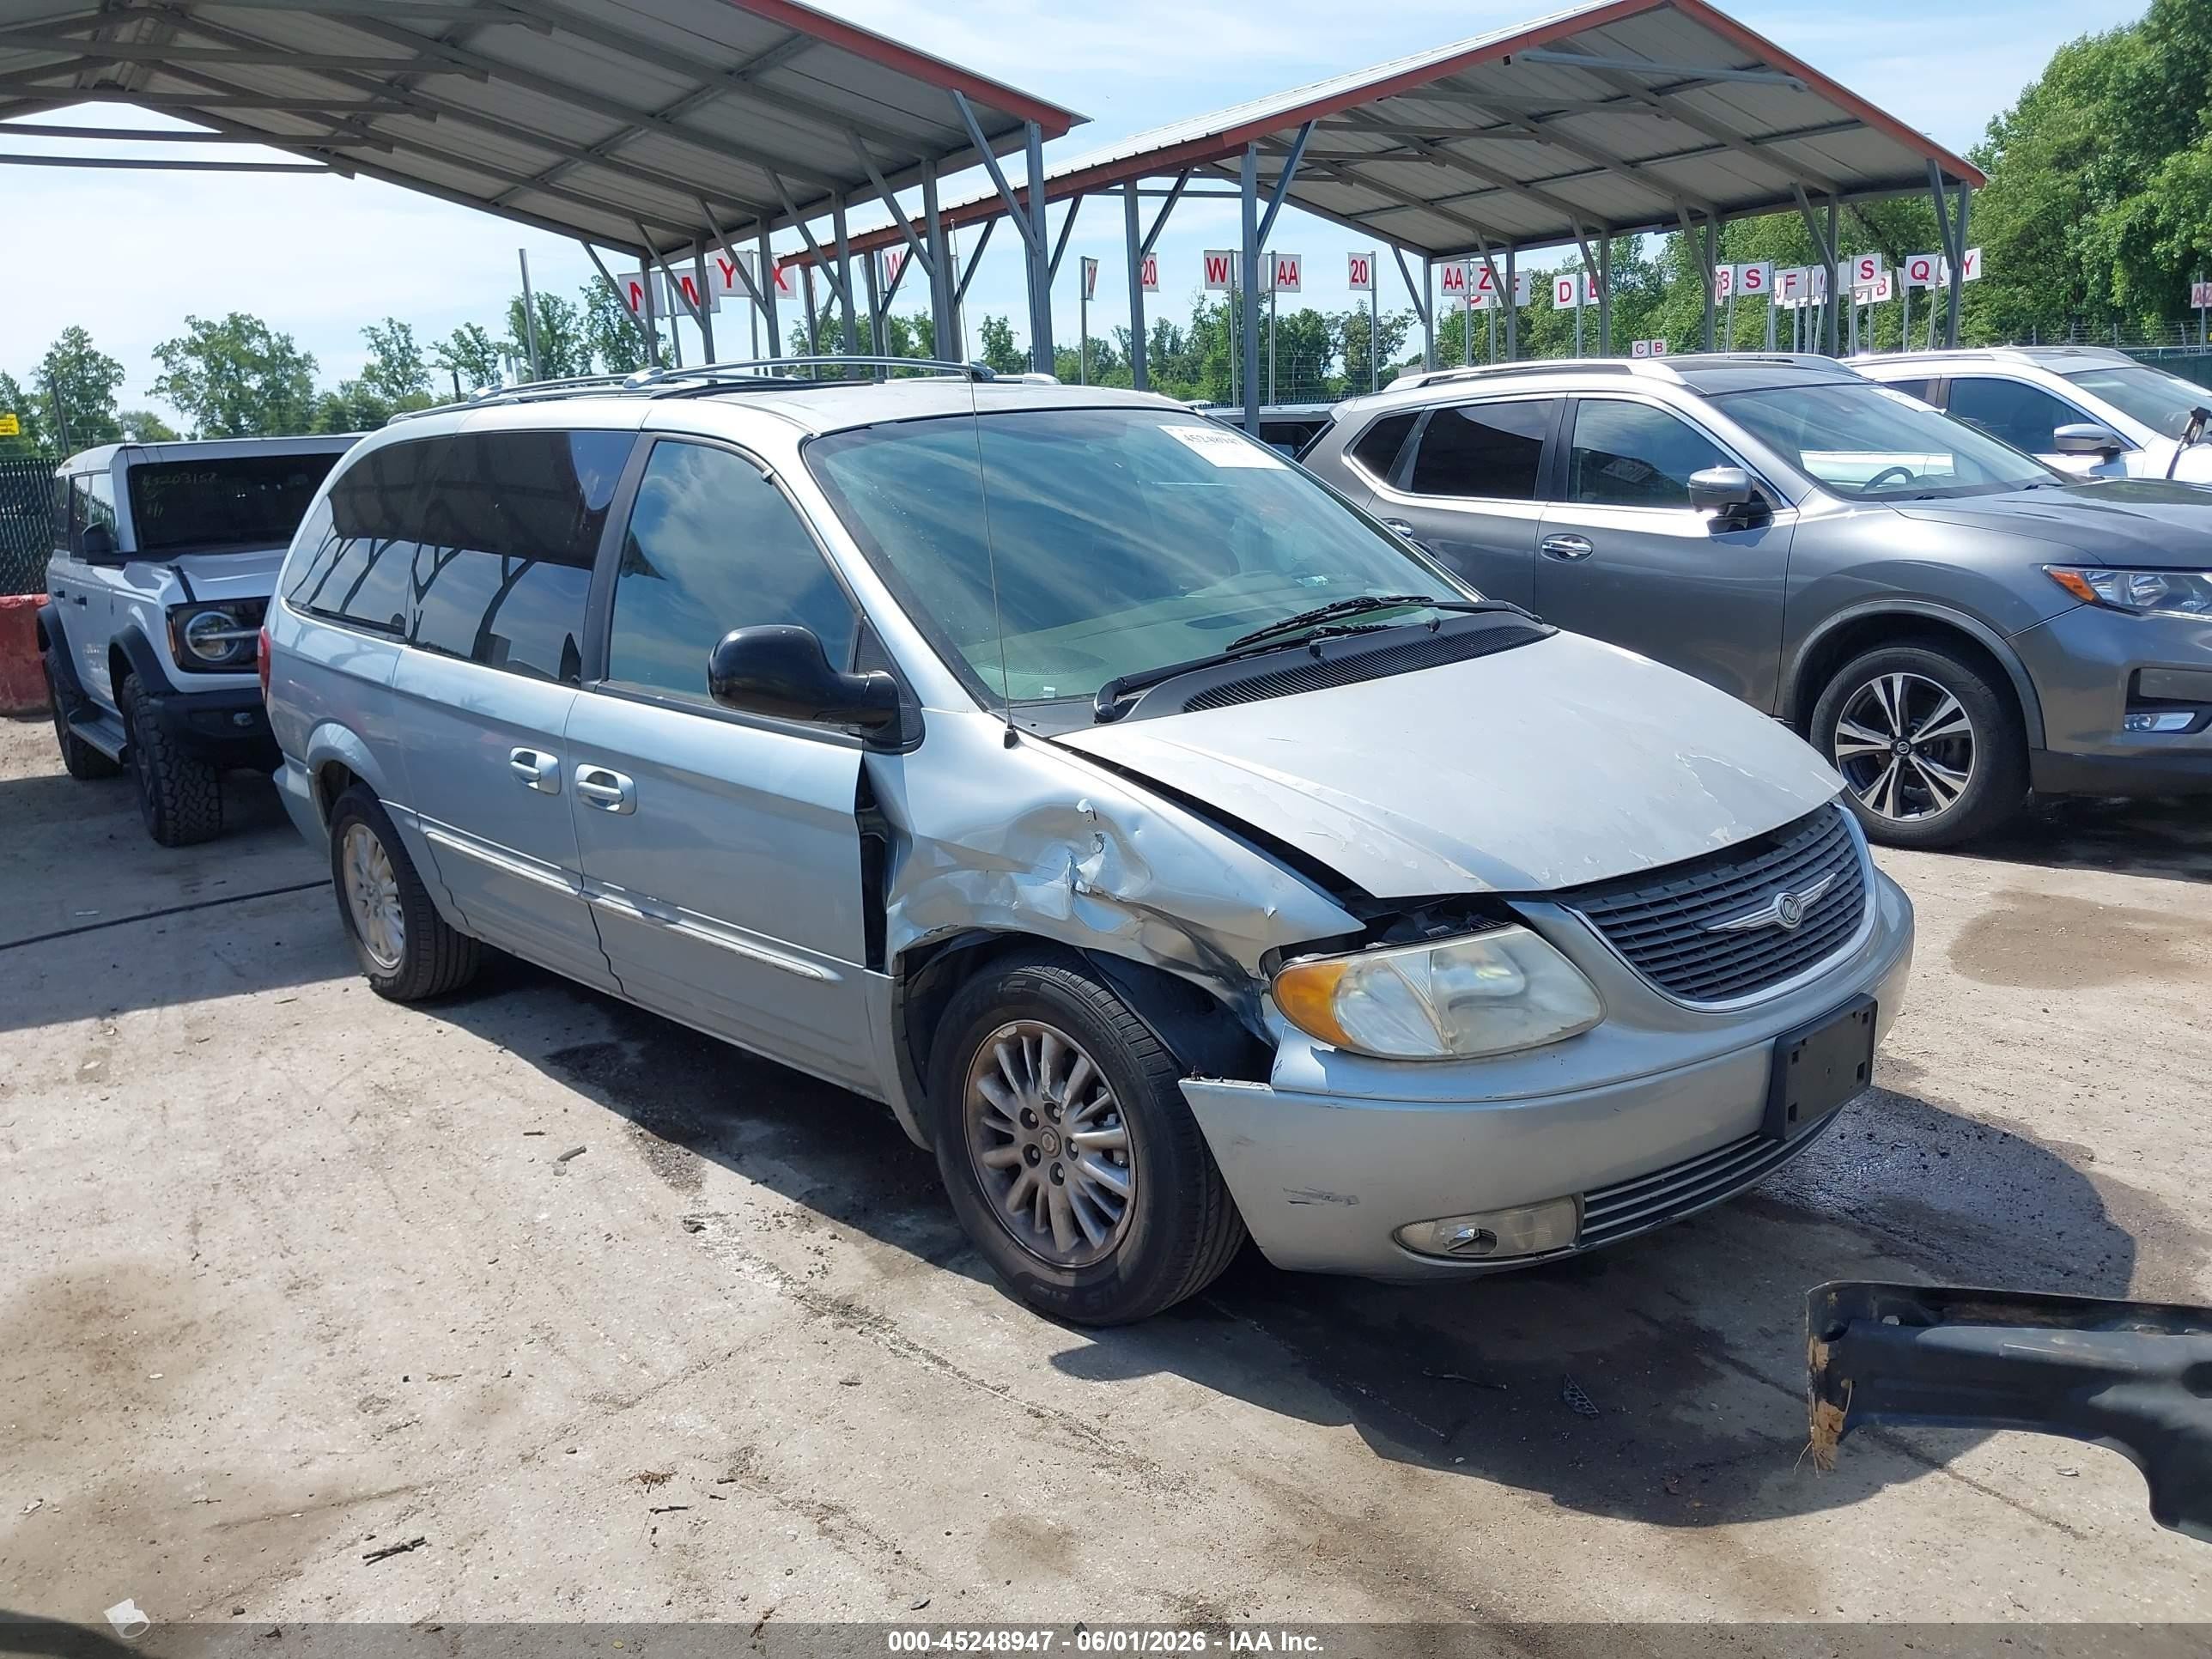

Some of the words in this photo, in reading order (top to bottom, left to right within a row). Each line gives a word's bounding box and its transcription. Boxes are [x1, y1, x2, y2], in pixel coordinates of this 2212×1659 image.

[716, 258, 737, 289] Y
[1141, 259, 1157, 286] 20
[1206, 257, 1228, 283] W
[1276, 260, 1299, 286] AA
[1350, 259, 1368, 284] 20
[1860, 259, 1875, 281] S
[1910, 259, 1930, 282] Q
[1963, 254, 1975, 276] Y
[1443, 267, 1465, 290] AA
[1478, 267, 1493, 290] Z
[1745, 268, 1761, 289] S
[1785, 274, 1797, 295] F
[1876, 276, 1887, 296] B
[1559, 281, 1572, 303] D
[1635, 343, 1645, 355] C
[1654, 342, 1664, 353] B
